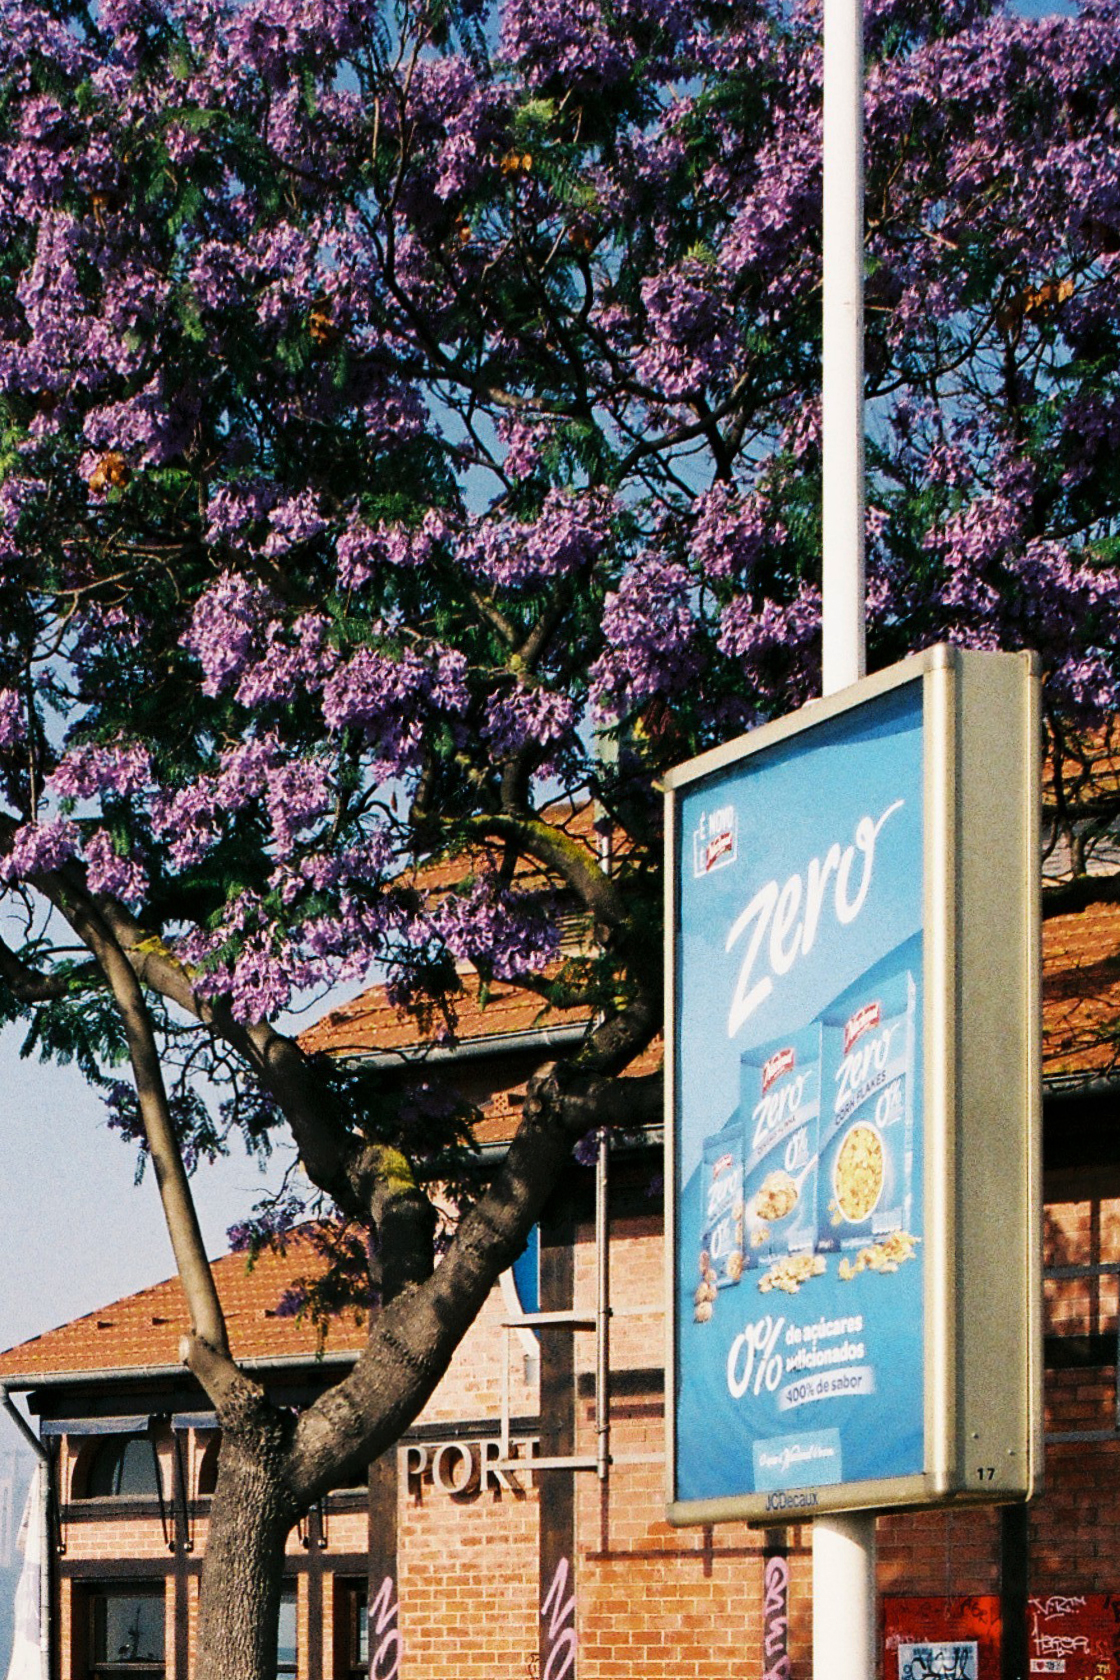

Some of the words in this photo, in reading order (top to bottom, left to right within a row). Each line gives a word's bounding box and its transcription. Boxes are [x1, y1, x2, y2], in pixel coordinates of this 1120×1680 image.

[785, 1323, 802, 1346] de
[726, 1314, 786, 1400] 0%
[785, 1382, 815, 1403] 100%
[816, 1379, 830, 1396] de
[831, 1375, 863, 1392] sabor
[977, 1467, 996, 1481] 17
[765, 1492, 819, 1512] JCDecaux
